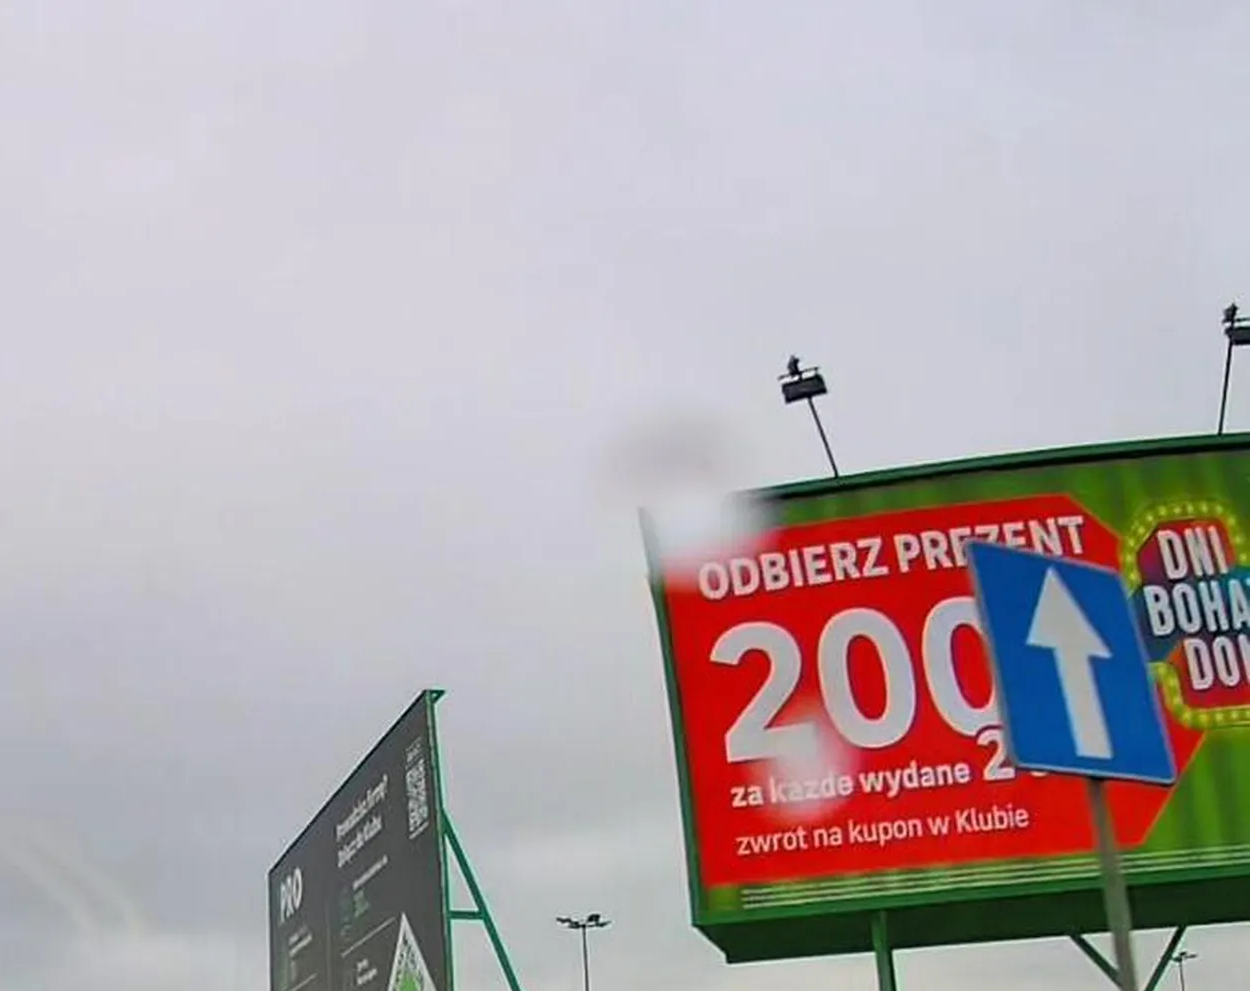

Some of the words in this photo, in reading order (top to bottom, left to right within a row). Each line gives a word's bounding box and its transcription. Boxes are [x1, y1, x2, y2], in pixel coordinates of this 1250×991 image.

[698, 536, 890, 601] ODBIERZ
[1156, 525, 1229, 580] DNI
[1143, 578, 1250, 637] BOHA
[710, 596, 1003, 764] 200
[731, 784, 763, 808] za
[858, 760, 971, 798] wydane
[736, 825, 809, 856] zwrot
[813, 829, 844, 848] na
[849, 816, 923, 847] kupon
[923, 815, 950, 836] w
[955, 803, 1030, 834] Klubie
[280, 866, 303, 923] PRO
